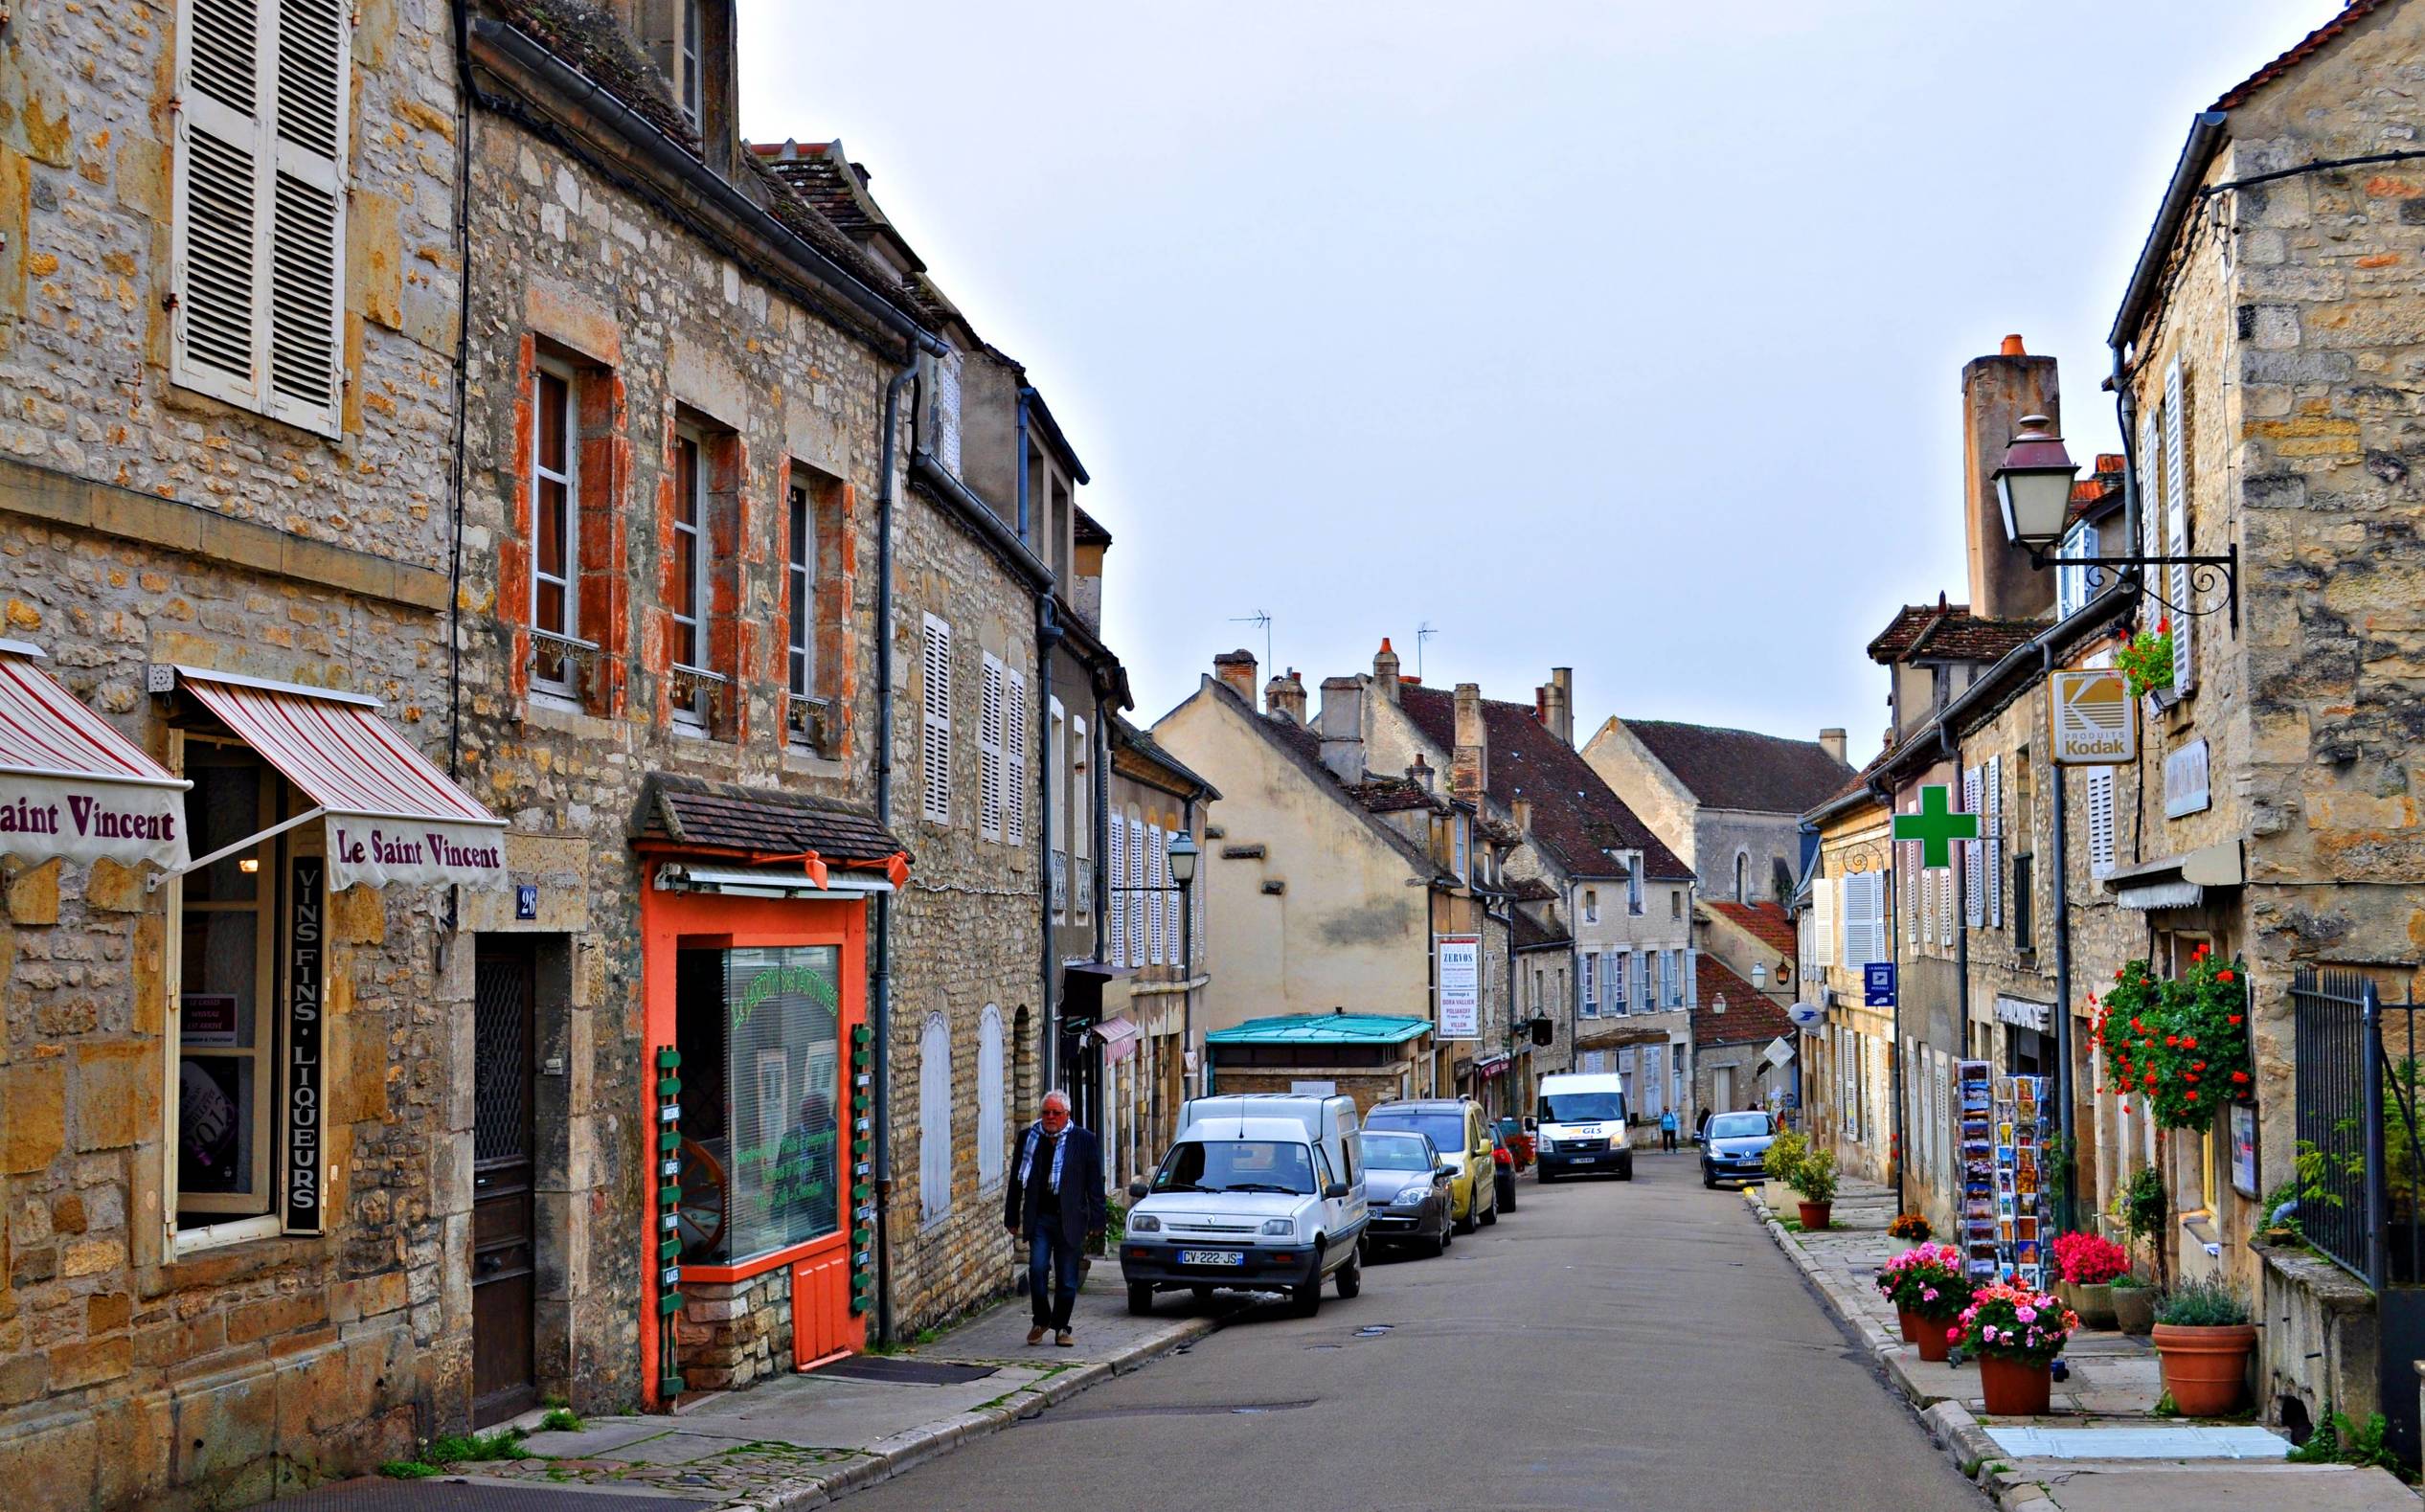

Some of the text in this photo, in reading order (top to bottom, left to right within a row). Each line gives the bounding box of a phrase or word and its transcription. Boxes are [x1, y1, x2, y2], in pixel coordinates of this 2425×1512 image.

[2064, 732, 2125, 740] PRODUITS
[2065, 739, 2125, 756] Kodak
[0, 795, 175, 841] aint Vincent
[337, 829, 501, 869] Le Saint Vincent
[521, 891, 535, 914] 26
[1443, 953, 1473, 963] ZERVOS
[1997, 998, 2050, 1031] PHARMACIE
[292, 869, 319, 1209] VINS FINS LIQUEURS
[1184, 1252, 1237, 1264] CV-222-JS
